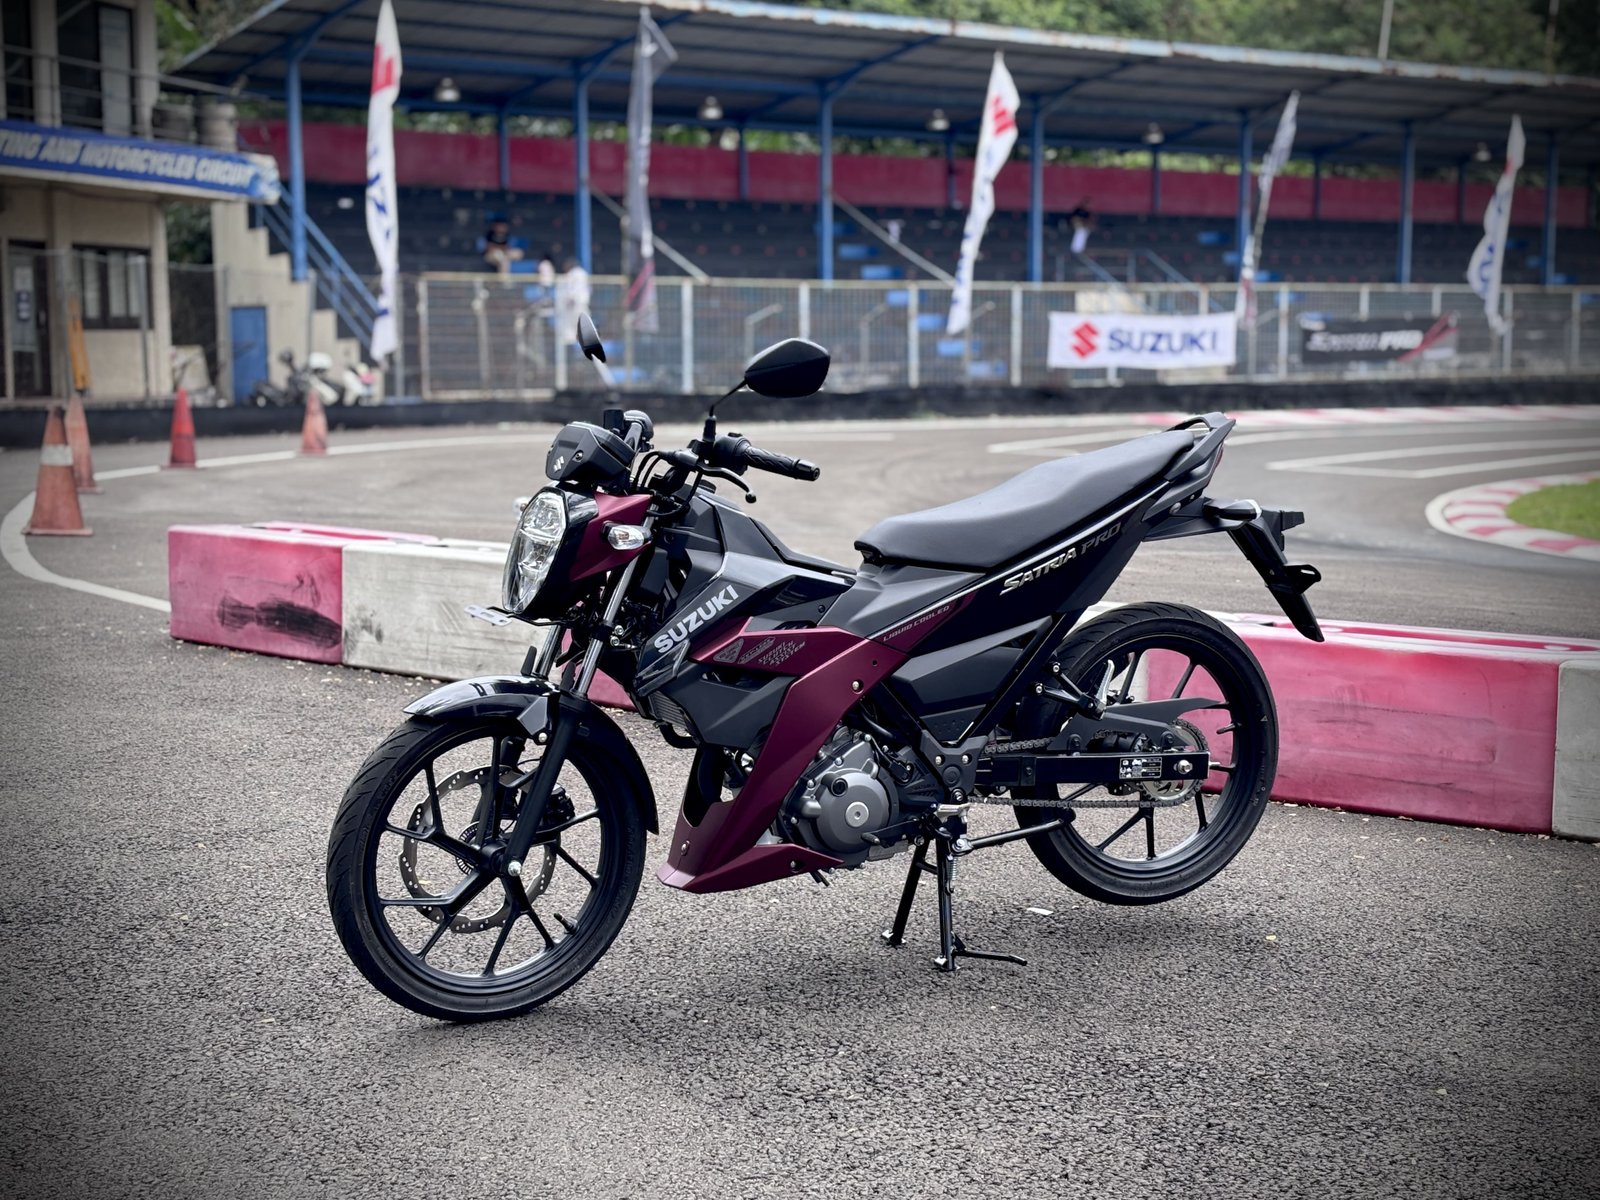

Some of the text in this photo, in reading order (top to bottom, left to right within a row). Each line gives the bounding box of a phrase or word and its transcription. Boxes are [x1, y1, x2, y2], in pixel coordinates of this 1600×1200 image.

[39, 136, 80, 164] AND
[80, 141, 196, 180] MOTORCYCLES
[195, 157, 256, 188] CIRCUIT
[1108, 328, 1218, 353] SUZUKI
[999, 522, 1122, 596] SATRIA PRO
[654, 585, 739, 653] SUZUKI
[883, 605, 950, 642] LIQUID COOLED
